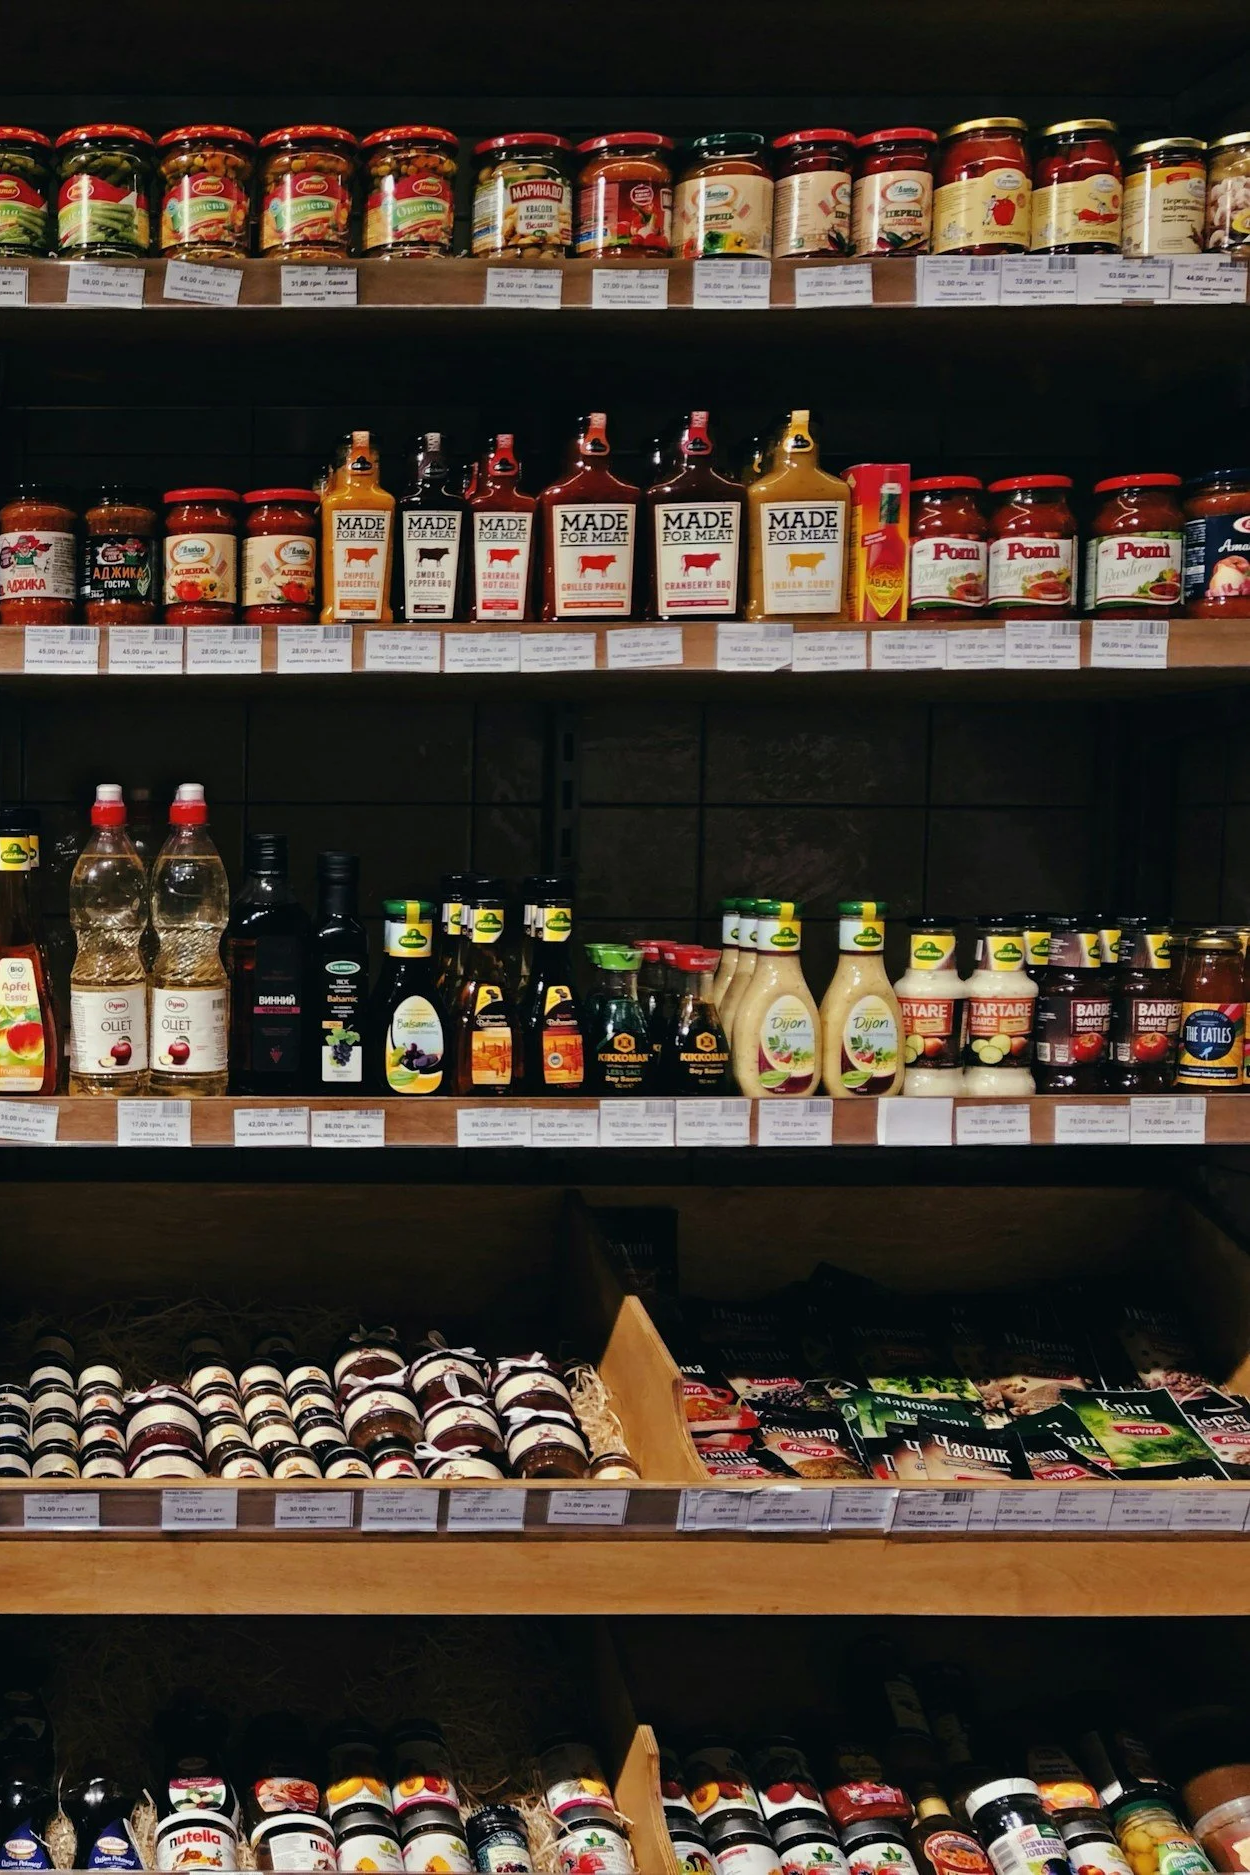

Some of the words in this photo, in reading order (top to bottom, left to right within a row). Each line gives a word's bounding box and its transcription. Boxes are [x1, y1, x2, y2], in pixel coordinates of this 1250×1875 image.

[197, 182, 220, 192] Jamar
[300, 182, 324, 192] Jamar
[511, 183, 562, 200] МАРИНАДО
[526, 205, 552, 213] КВАСОЛЯ
[885, 209, 922, 218] ПЕРЕЦЬ
[337, 517, 385, 531] MADE
[408, 517, 457, 531] MADE
[560, 513, 628, 531] MADE
[663, 511, 733, 529] MADE
[768, 510, 838, 528] MADE
[478, 518, 528, 532] MADE
[336, 531, 355, 539] FOR
[357, 531, 385, 539] MEAT
[408, 531, 426, 539] FOR
[428, 531, 457, 539] MEAT
[478, 532, 498, 540] FOR
[499, 532, 528, 540] MEAT
[561, 532, 587, 542] FOR
[589, 531, 629, 542] MEAT
[663, 530, 689, 541] FOR
[692, 530, 734, 541] MEAT
[768, 530, 795, 540] FOR
[798, 529, 839, 540] MEAT
[93, 564, 144, 580] АДЖИКА
[174, 567, 209, 577] АДЖИКА
[281, 569, 312, 577] АДЖИКА
[343, 572, 375, 580] CHIPOTLE
[416, 571, 445, 579] SMOKED
[482, 572, 520, 580] SRIRACHA
[6, 578, 47, 592] АДЖИКА
[104, 580, 130, 589] ГОСТРА
[408, 579, 432, 588] PEPPER
[435, 579, 452, 588] BBQ
[561, 582, 592, 591] GRILLED
[595, 582, 626, 591] PAPRIKA
[665, 582, 714, 590] CRANBERRY
[716, 581, 731, 589] BBQ
[58, 649, 71, 657] грн.
[221, 649, 234, 657] грн.
[770, 935, 799, 944] Kühne
[854, 935, 882, 944] Kühne
[913, 949, 943, 958] Kühne
[996, 951, 1022, 959] Kühne
[2, 981, 31, 994] Apfel
[4, 993, 28, 1004] Essig
[258, 995, 296, 1006] ВИННИЙ
[327, 995, 358, 1003] Balsamic
[971, 1002, 1032, 1018] TARTARE
[101, 1019, 132, 1033] ОЦЕТ
[162, 1018, 192, 1032] ОЦЕТ
[397, 1018, 436, 1030] Balsamic
[770, 1016, 807, 1032] Dijon
[853, 1016, 889, 1032] Dijon
[971, 1018, 998, 1027] SAUCE
[1076, 1018, 1102, 1027] SAUCE
[1138, 1017, 1167, 1026] SAUCE
[1186, 1026, 1198, 1044] THE
[1200, 1026, 1232, 1044] EATLES
[598, 1054, 649, 1063] KIKKOMAN
[680, 1053, 729, 1062] KIKKOMAN
[0, 1066, 30, 1078] fruchtig
[1096, 1398, 1152, 1416] Кріп
[760, 1424, 840, 1442] Коріандр
[932, 1433, 1013, 1466] Часник
[169, 1829, 221, 1851] nutella
